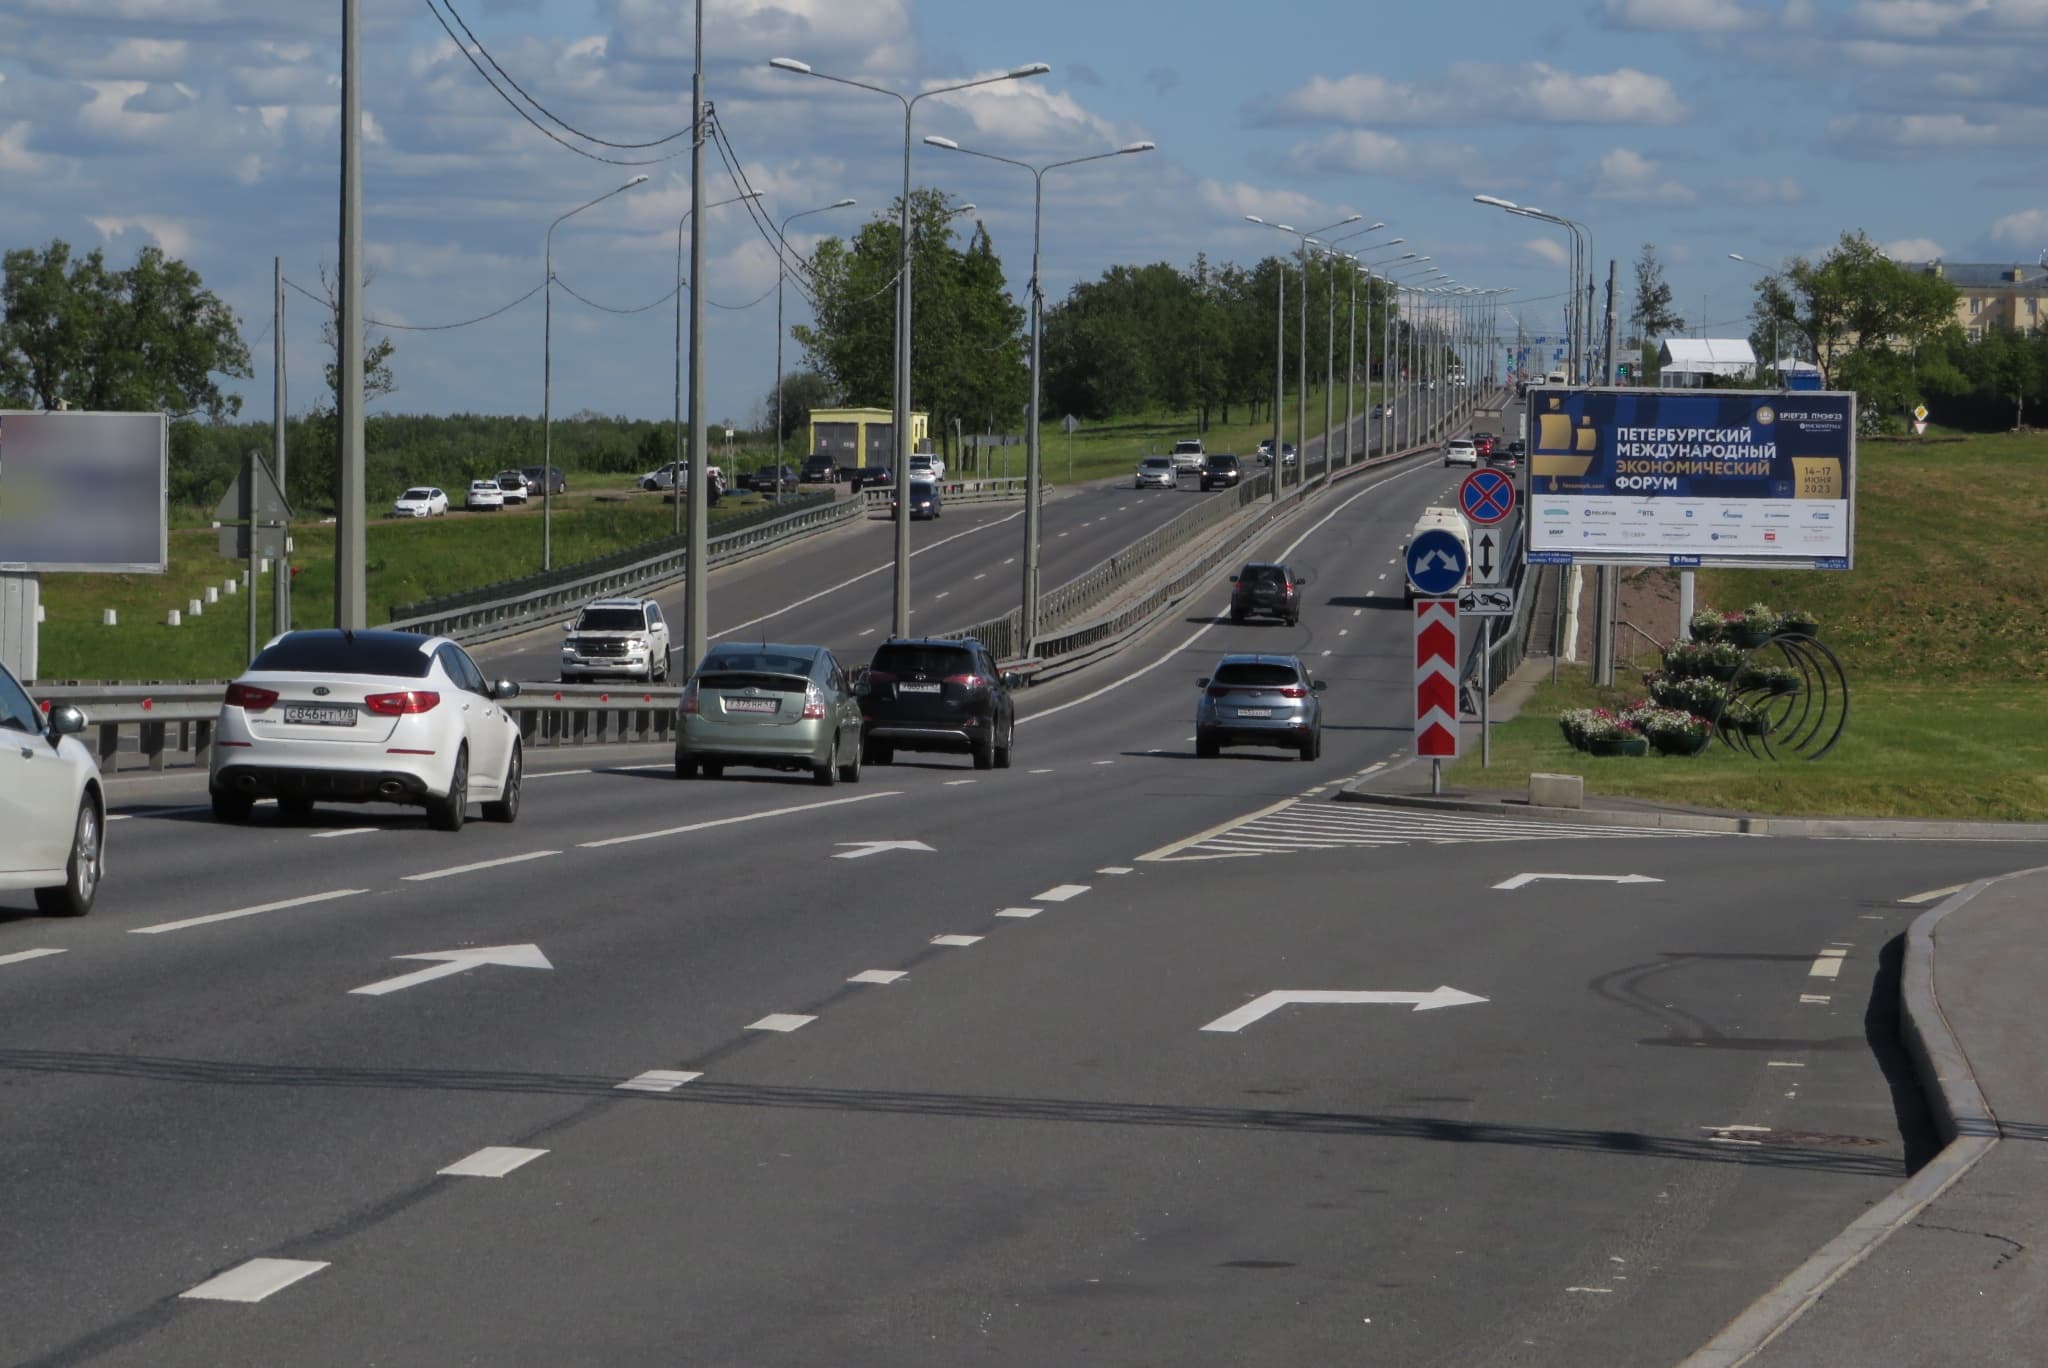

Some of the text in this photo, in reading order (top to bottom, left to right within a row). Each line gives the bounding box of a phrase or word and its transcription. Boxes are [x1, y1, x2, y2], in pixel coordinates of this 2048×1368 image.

[1617, 426, 1752, 443] ПЕТЕРБУРГСКИЙ
[1616, 442, 1777, 460] МЕЖДУНАРОДНЫЙ
[1615, 460, 1771, 476] ЭКОНОМИЧЕСКИЙ
[1615, 475, 1678, 491] ФОРУМ
[1804, 476, 1832, 484] ИЮНЯ
[1804, 484, 1831, 494] 2023
